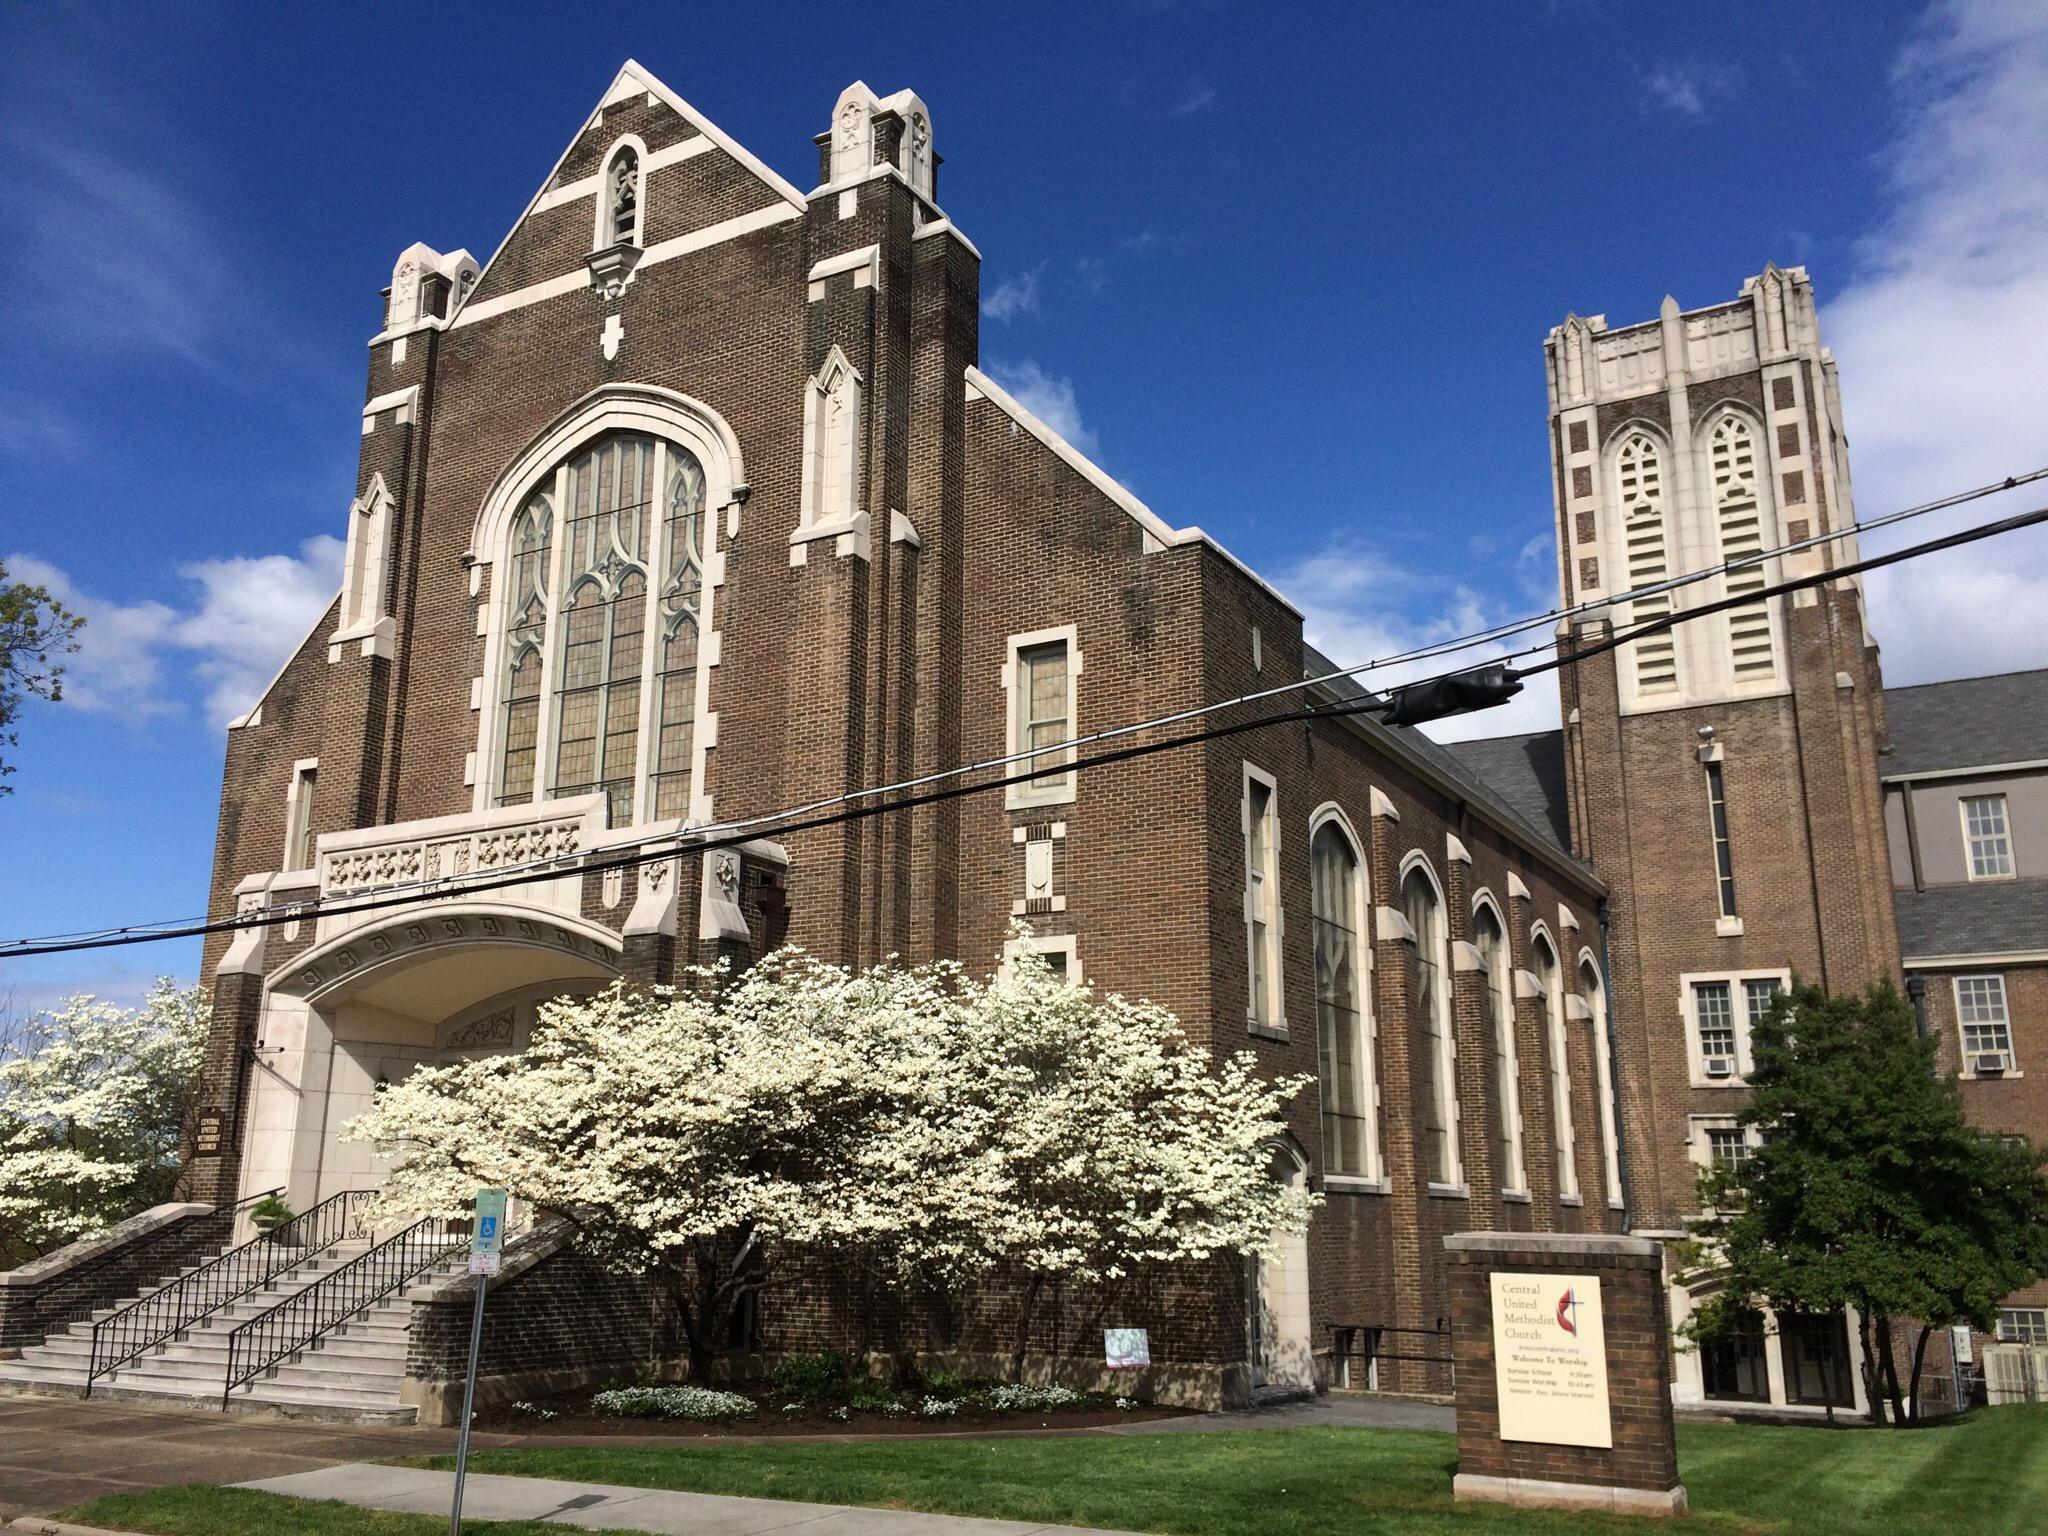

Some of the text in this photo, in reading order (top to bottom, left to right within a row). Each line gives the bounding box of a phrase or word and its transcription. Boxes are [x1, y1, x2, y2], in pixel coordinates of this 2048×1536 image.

[200, 1118, 220, 1126] CENTRAL
[1502, 1283, 1540, 1294] Central
[1504, 1298, 1537, 1309] United
[1504, 1313, 1554, 1325] Methodist
[1505, 1327, 1542, 1339] Church
[1512, 1354, 1588, 1367] Welcome To Worship
